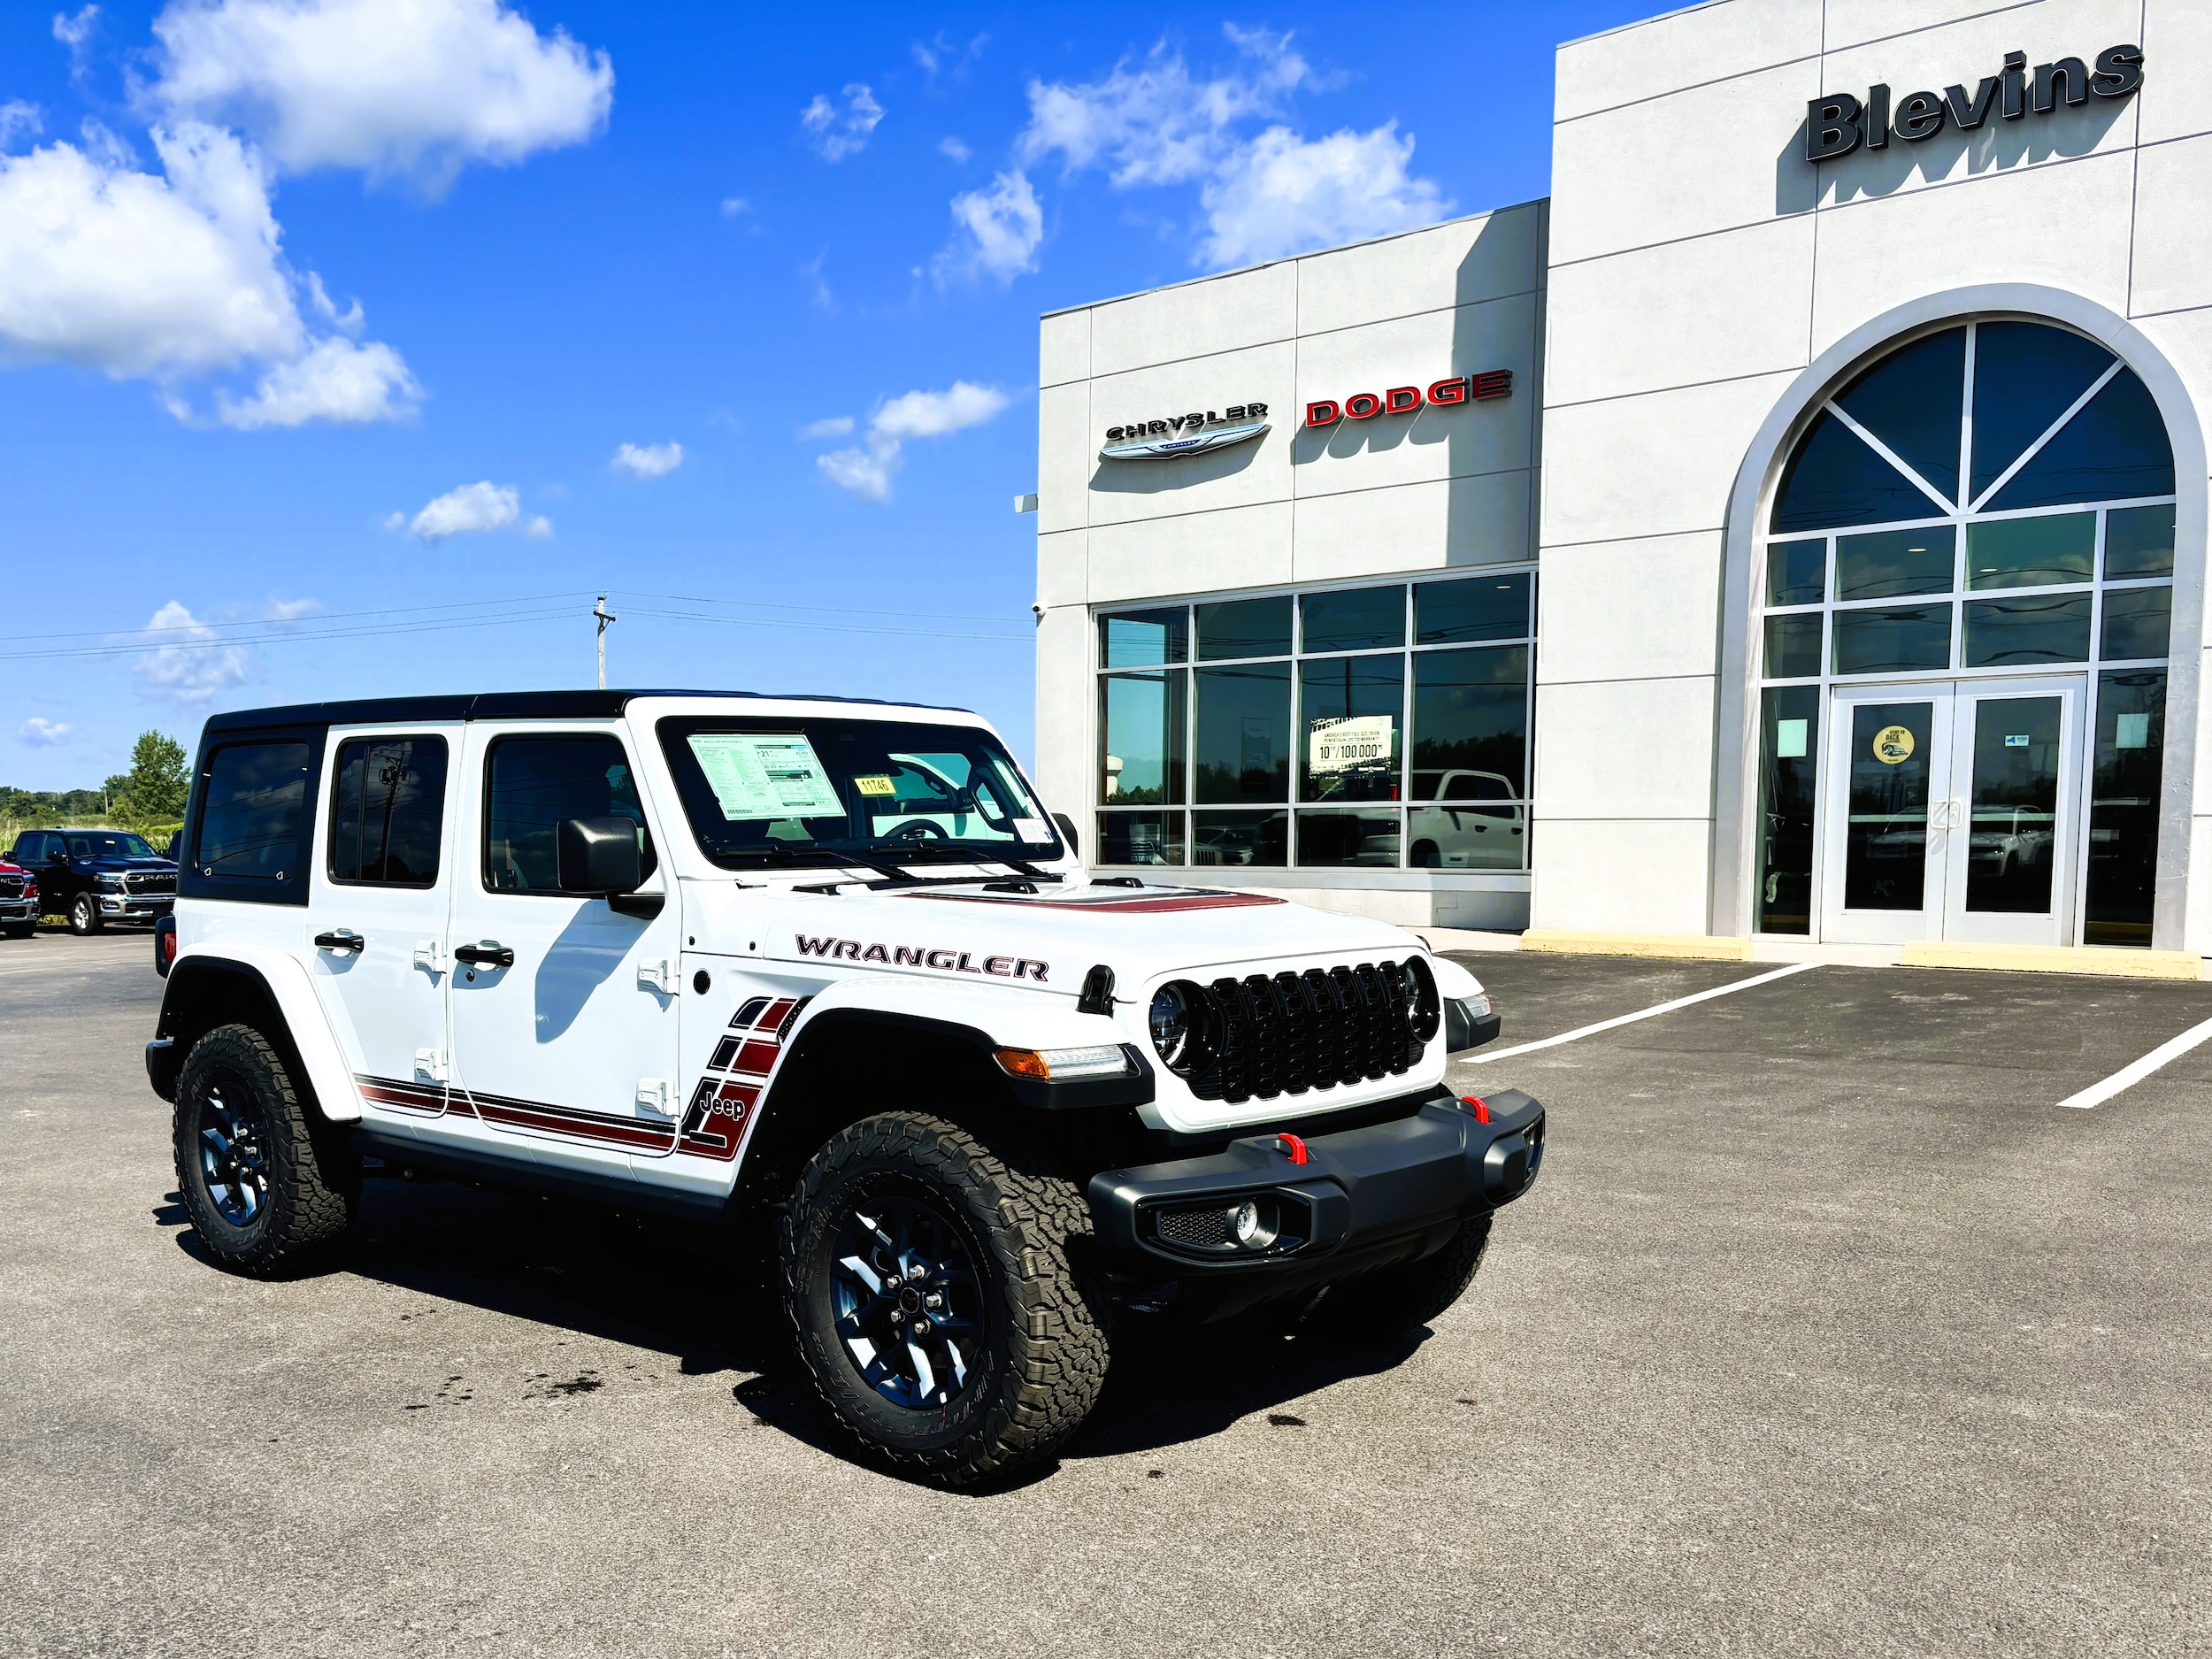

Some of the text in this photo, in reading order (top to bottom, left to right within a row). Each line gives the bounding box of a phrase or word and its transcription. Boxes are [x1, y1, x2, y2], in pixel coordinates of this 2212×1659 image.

[1806, 44, 2145, 163] Blevins
[1306, 369, 1513, 427] DODGE
[1106, 403, 1269, 441] CHRYSLER
[862, 780, 889, 792] 11746
[795, 934, 1049, 981] WRANGLER
[699, 1090, 746, 1122] Jeep
